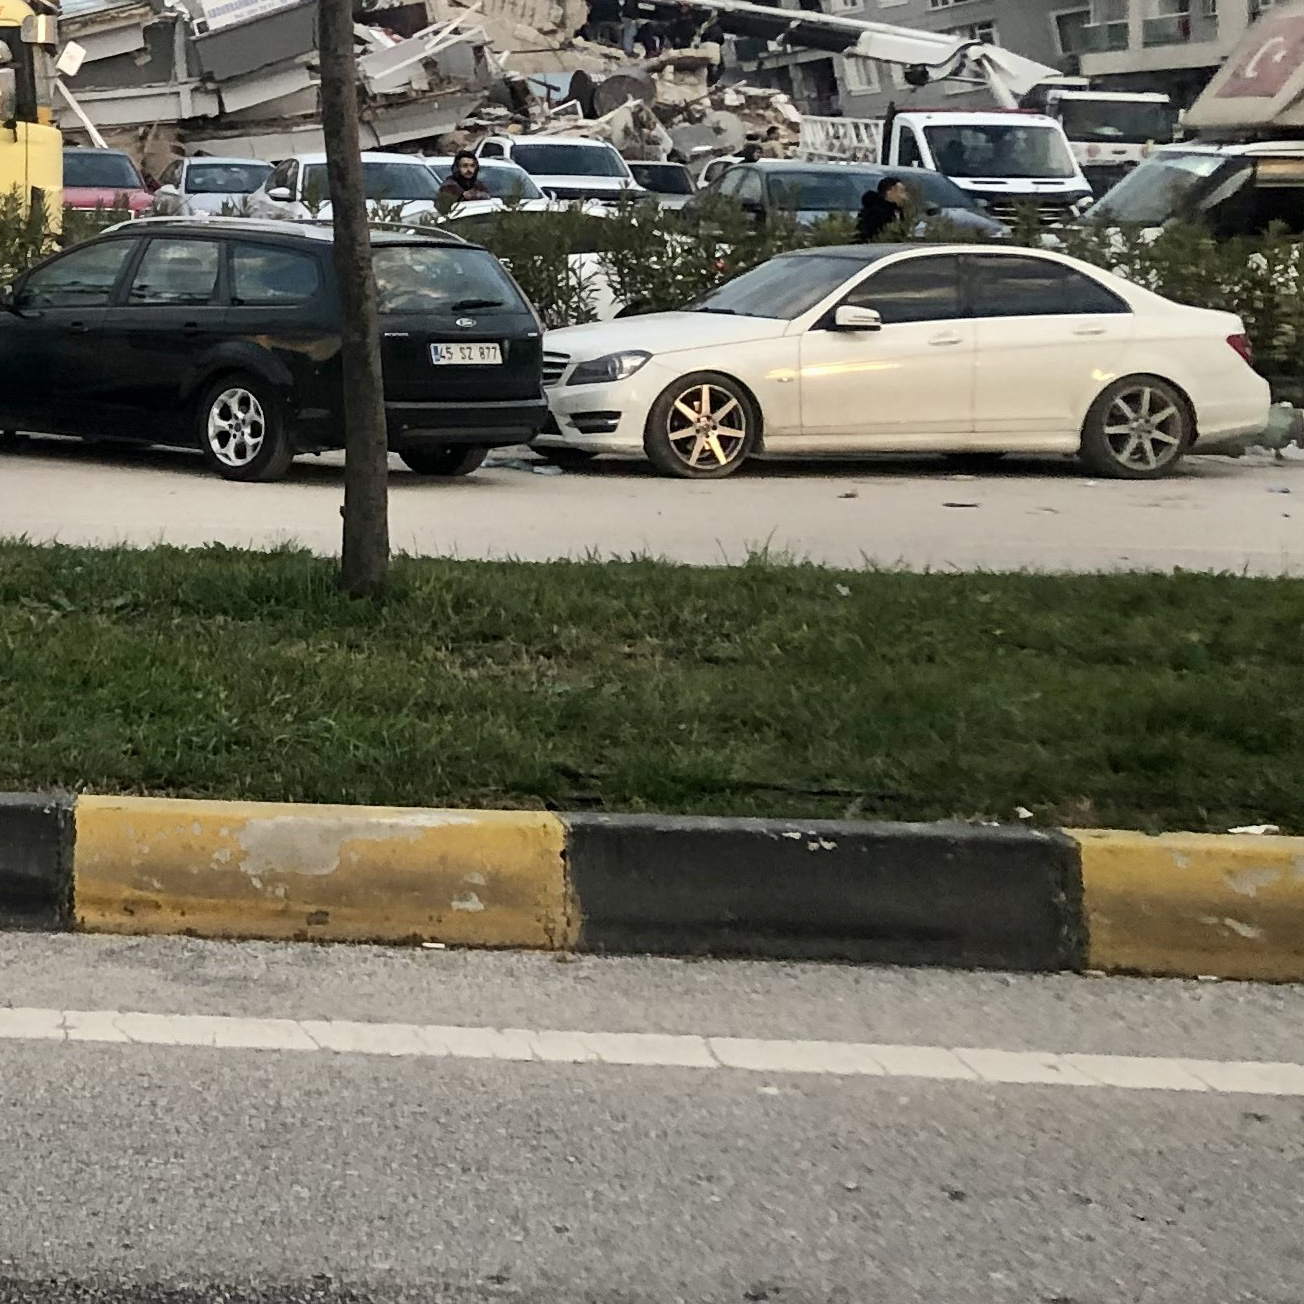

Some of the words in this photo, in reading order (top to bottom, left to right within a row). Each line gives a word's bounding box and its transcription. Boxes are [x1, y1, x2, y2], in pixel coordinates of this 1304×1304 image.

[440, 346, 454, 360] 45
[459, 346, 474, 361] SZ
[478, 346, 498, 360] 877
